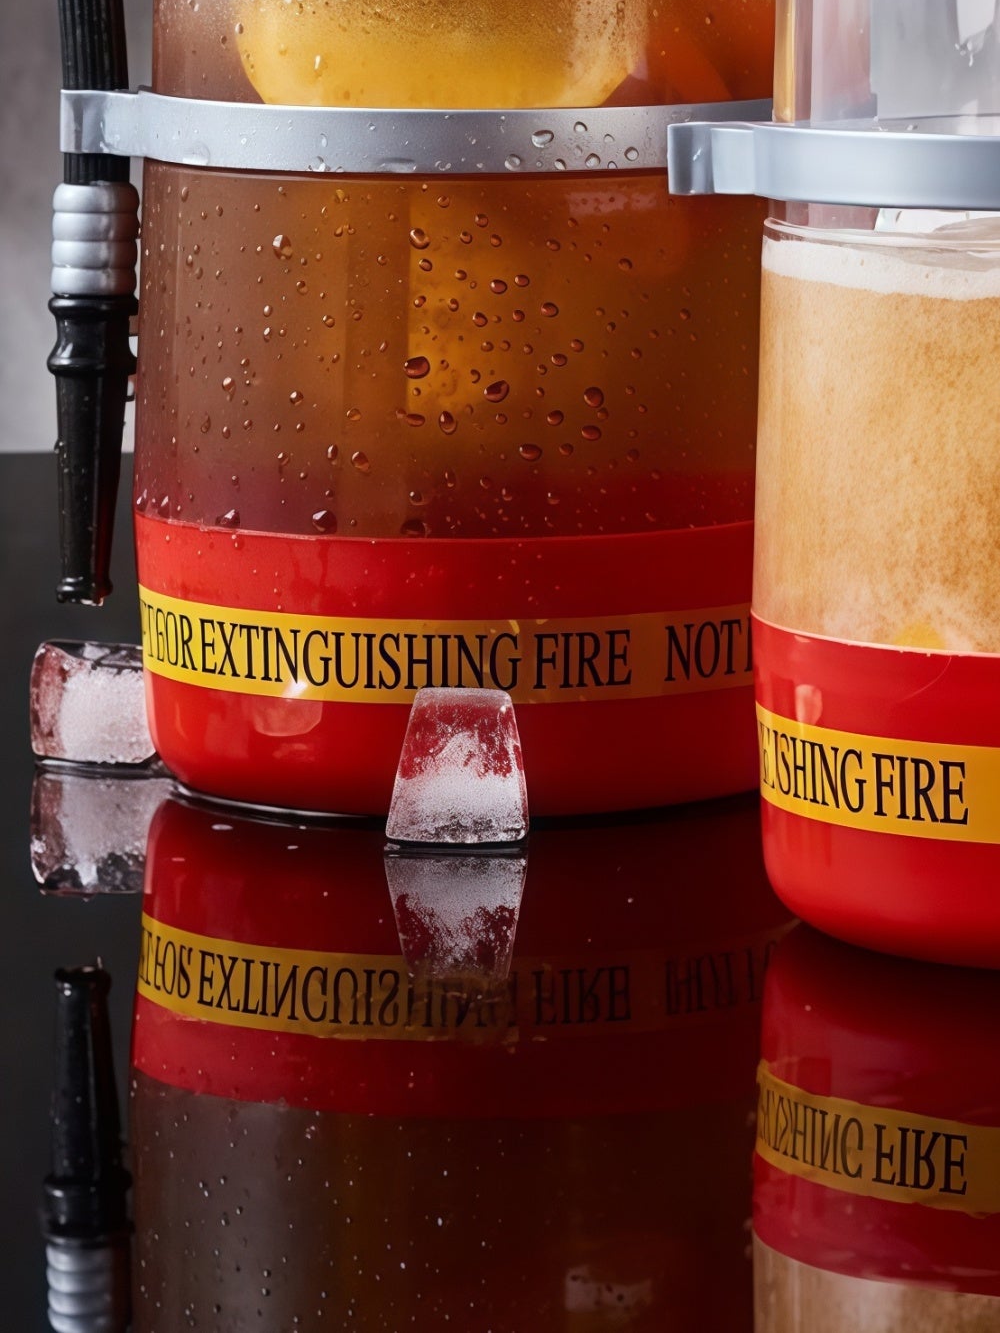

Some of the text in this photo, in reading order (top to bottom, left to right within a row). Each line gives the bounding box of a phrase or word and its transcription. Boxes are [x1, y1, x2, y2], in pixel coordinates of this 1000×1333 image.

[199, 617, 520, 690] EXTINGUISHING
[532, 629, 632, 690] FIRE
[664, 618, 742, 681] NOT
[871, 752, 969, 826] FIRE
